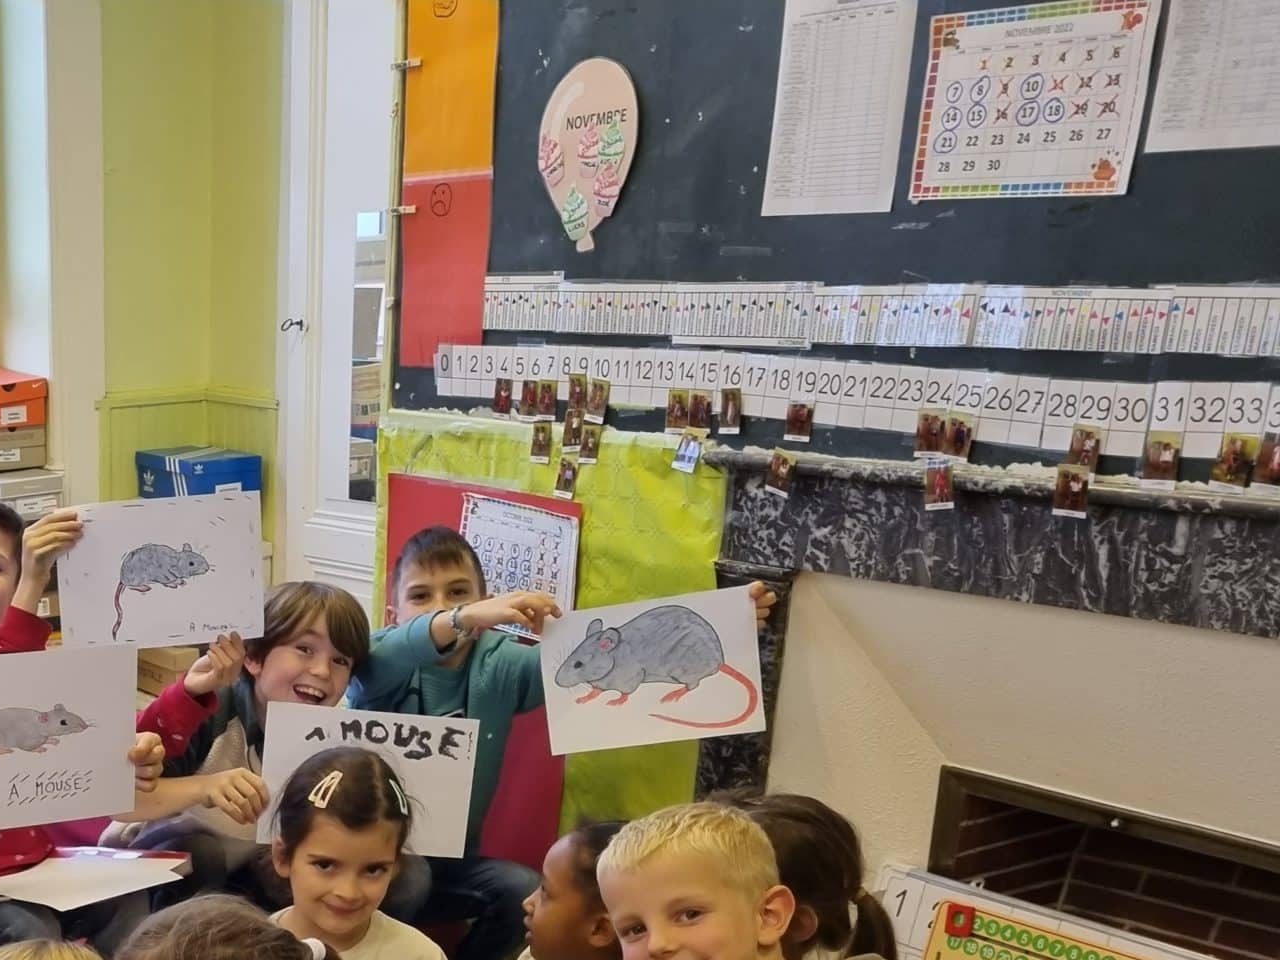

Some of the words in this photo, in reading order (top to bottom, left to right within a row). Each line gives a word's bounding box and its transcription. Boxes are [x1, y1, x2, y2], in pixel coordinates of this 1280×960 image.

[1058, 52, 1067, 63] 4
[1085, 49, 1093, 61] 5
[1025, 80, 1039, 92] 10
[945, 112, 958, 123] 14
[970, 109, 983, 121] 15
[1022, 106, 1035, 118] 17
[1047, 104, 1061, 116] 18
[941, 137, 953, 148] 21
[966, 135, 979, 147] 22
[991, 134, 1004, 146] 23
[1017, 132, 1031, 144] 24
[1043, 131, 1057, 143] 25
[1068, 129, 1084, 141] 26
[1096, 128, 1111, 140] 27
[937, 161, 951, 173] 28
[962, 160, 976, 171] 29
[987, 159, 1001, 171] 30
[440, 353, 449, 372] 0
[456, 354, 462, 373] 1
[470, 355, 478, 373] 2
[485, 356, 494, 374] 3
[500, 356, 509, 375] 4
[516, 356, 525, 374] 5
[531, 357, 541, 376] 6
[547, 356, 555, 374] 7
[562, 356, 571, 375] 8
[579, 357, 588, 374] 9
[595, 359, 610, 378] 10
[615, 360, 630, 379] 11
[635, 360, 652, 380] 12
[657, 360, 674, 381] 13
[678, 361, 695, 381] 14
[699, 363, 718, 383] 15
[722, 364, 741, 386] 16
[746, 367, 765, 388] 17
[771, 368, 791, 390] 18
[796, 371, 816, 393] 19
[819, 373, 841, 396] 20
[844, 375, 867, 398] 21
[870, 376, 897, 399] 22
[898, 378, 924, 402] 23
[926, 380, 953, 404] 24
[955, 383, 982, 408] 25
[984, 386, 1013, 412] 26
[1016, 389, 1045, 414] 27
[1048, 393, 1077, 418] 28
[1080, 394, 1112, 420] 29
[1115, 396, 1148, 423] 30
[1155, 396, 1184, 422] 31
[1190, 397, 1226, 423] 32
[1228, 398, 1263, 424] 33
[189, 622, 196, 633] A
[340, 719, 473, 760] MOUSE!
[8, 783, 20, 800] A
[35, 777, 82, 797] MOUSE
[896, 889, 908, 918] 1
[950, 937, 960, 946] 17
[966, 941, 976, 952] 18
[983, 947, 992, 957] 19
[973, 919, 980, 929] 2
[989, 923, 996, 933] 3
[1004, 929, 1012, 938] 4
[1021, 934, 1028, 944] 5
[1037, 938, 1044, 948] 6
[1054, 943, 1062, 954] 7
[1070, 948, 1077, 959] 8
